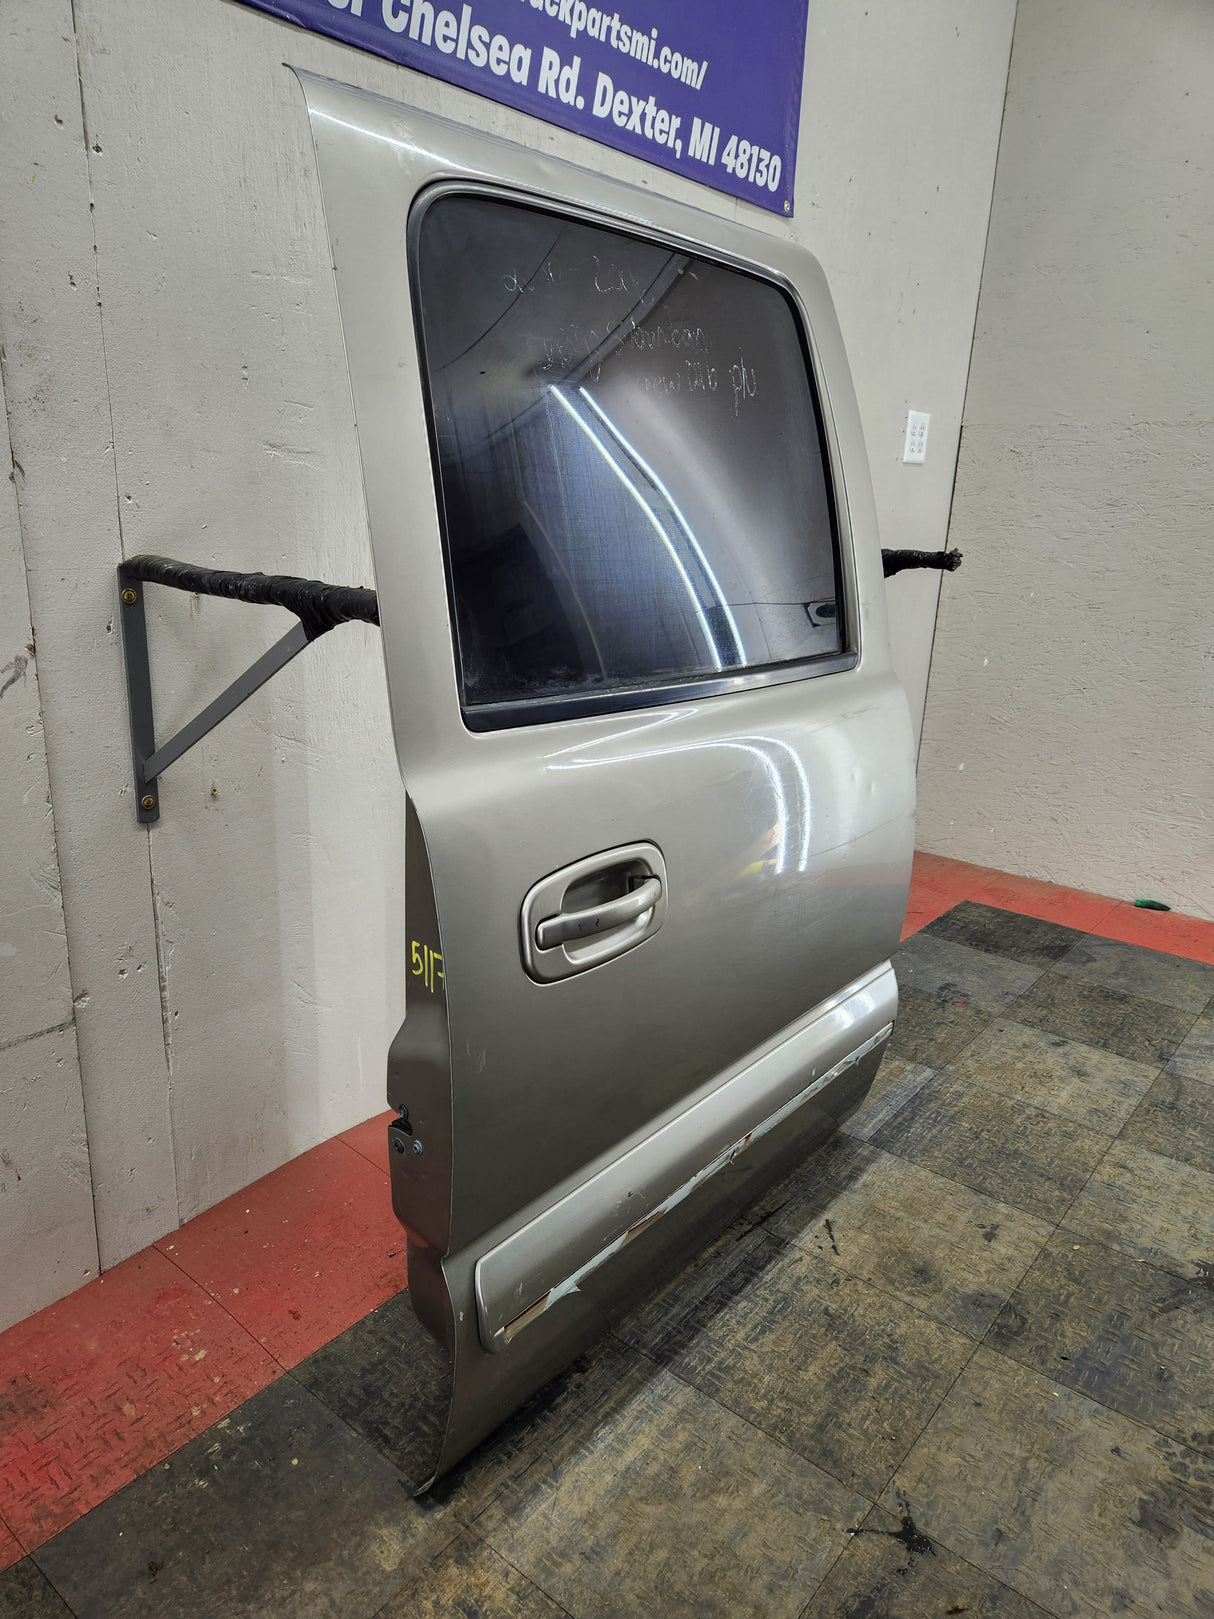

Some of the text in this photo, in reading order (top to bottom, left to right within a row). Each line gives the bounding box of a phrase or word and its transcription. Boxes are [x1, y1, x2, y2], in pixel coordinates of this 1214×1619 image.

[382, 0, 781, 191] Chelsea Rd. Dexter, MI 48130
[521, 0, 708, 90] ckpartsmi.com/
